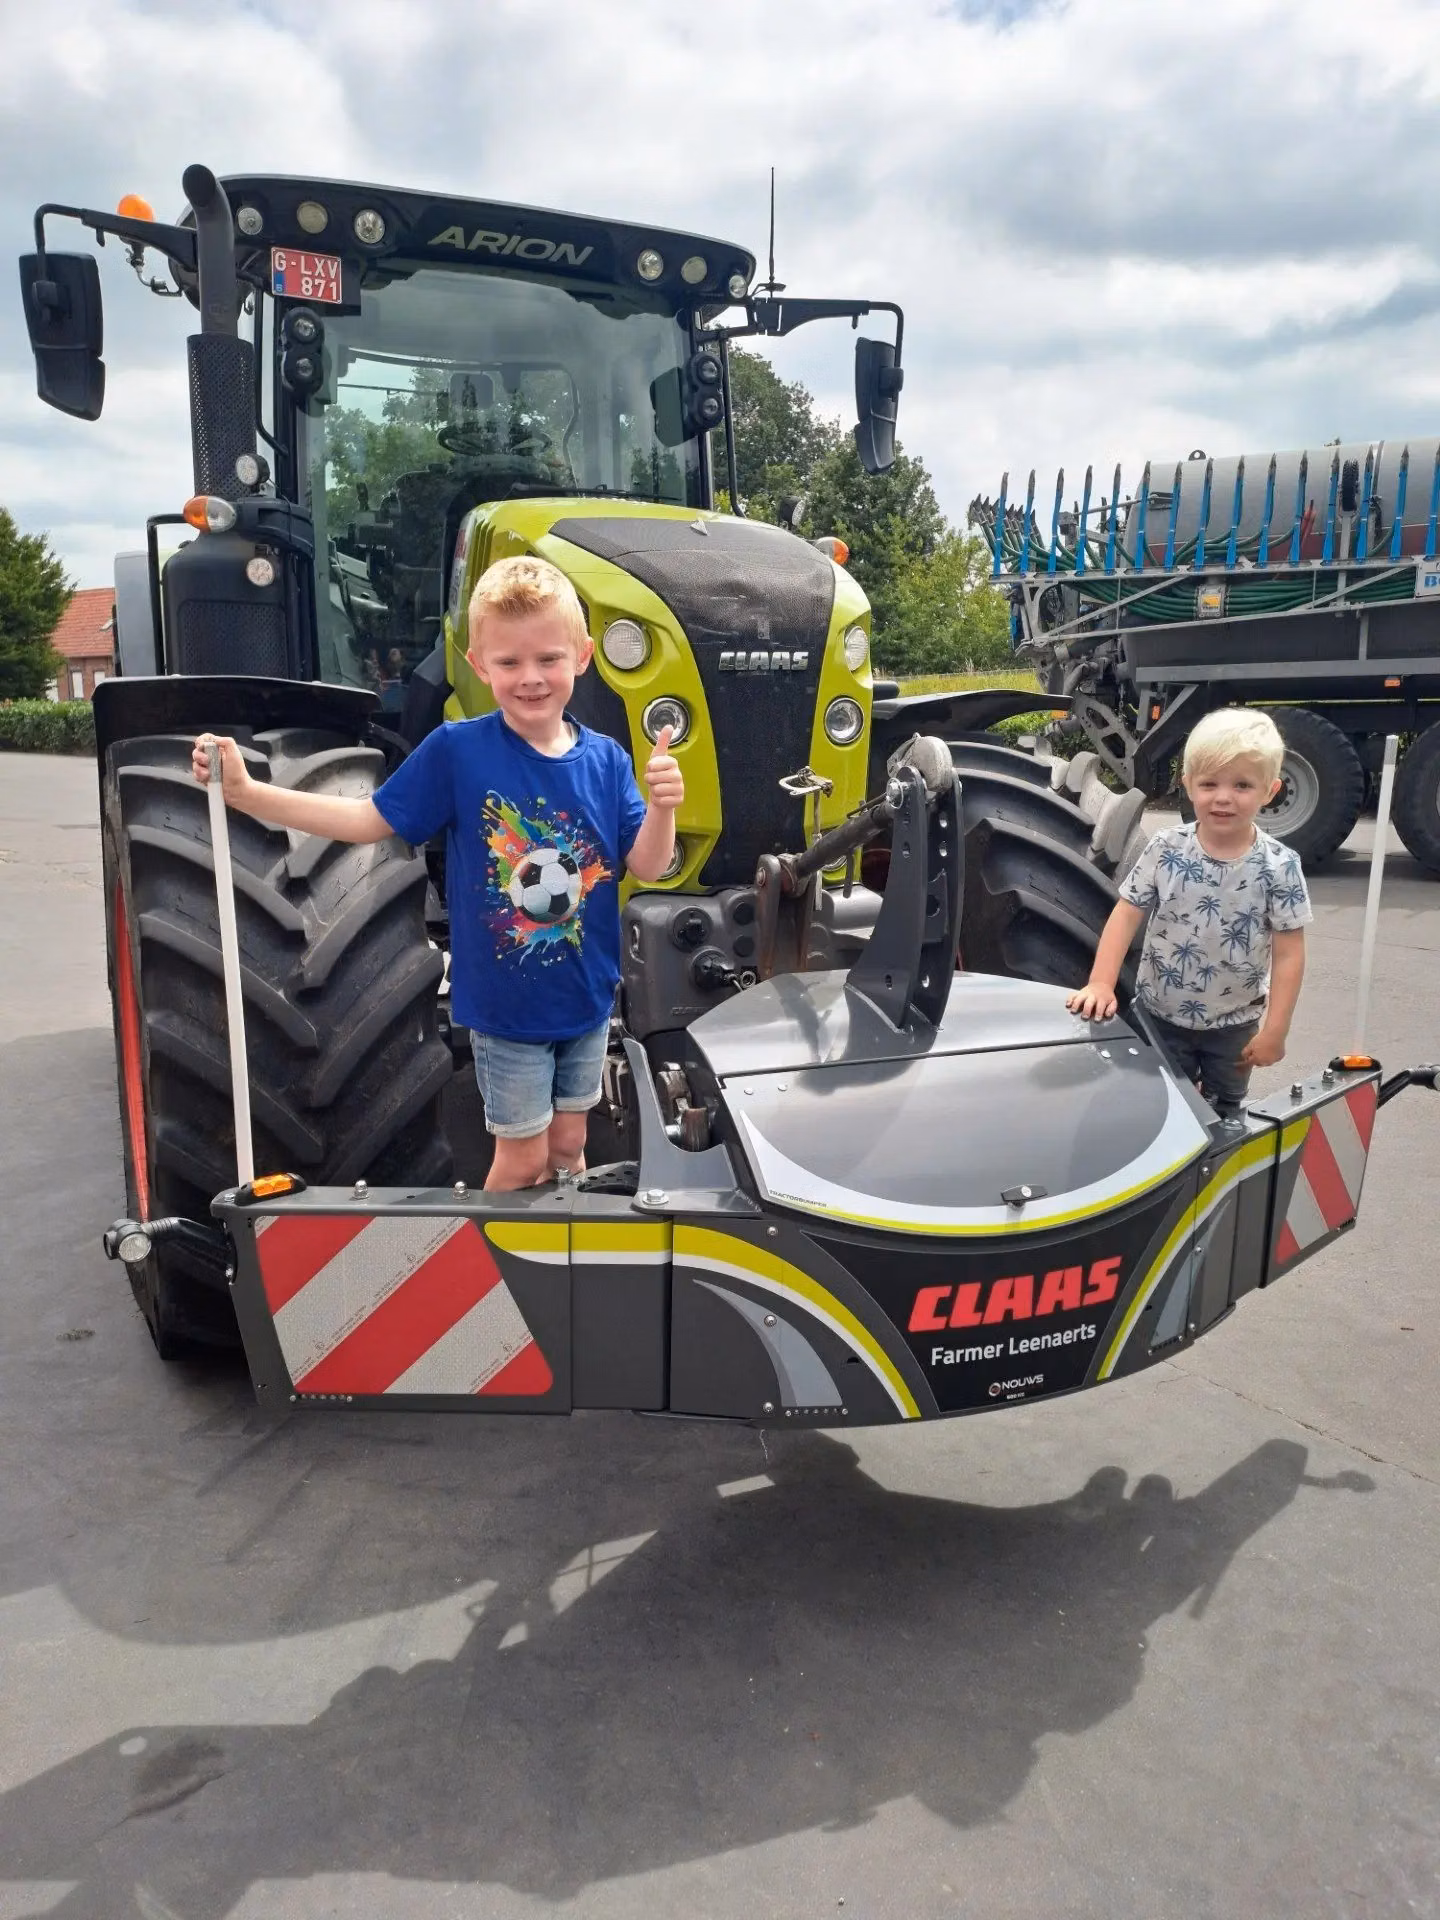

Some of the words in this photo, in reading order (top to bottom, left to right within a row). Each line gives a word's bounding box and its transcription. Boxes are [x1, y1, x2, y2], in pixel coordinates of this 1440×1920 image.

[427, 225, 594, 265] ARION
[301, 276, 337, 300] 871
[718, 651, 809, 670] CLAAS
[907, 1256, 1122, 1332] CLAAS
[931, 1343, 1004, 1366] Farmer
[1008, 1323, 1096, 1356] Leenaerts
[1002, 1373, 1044, 1390] NOUWS
